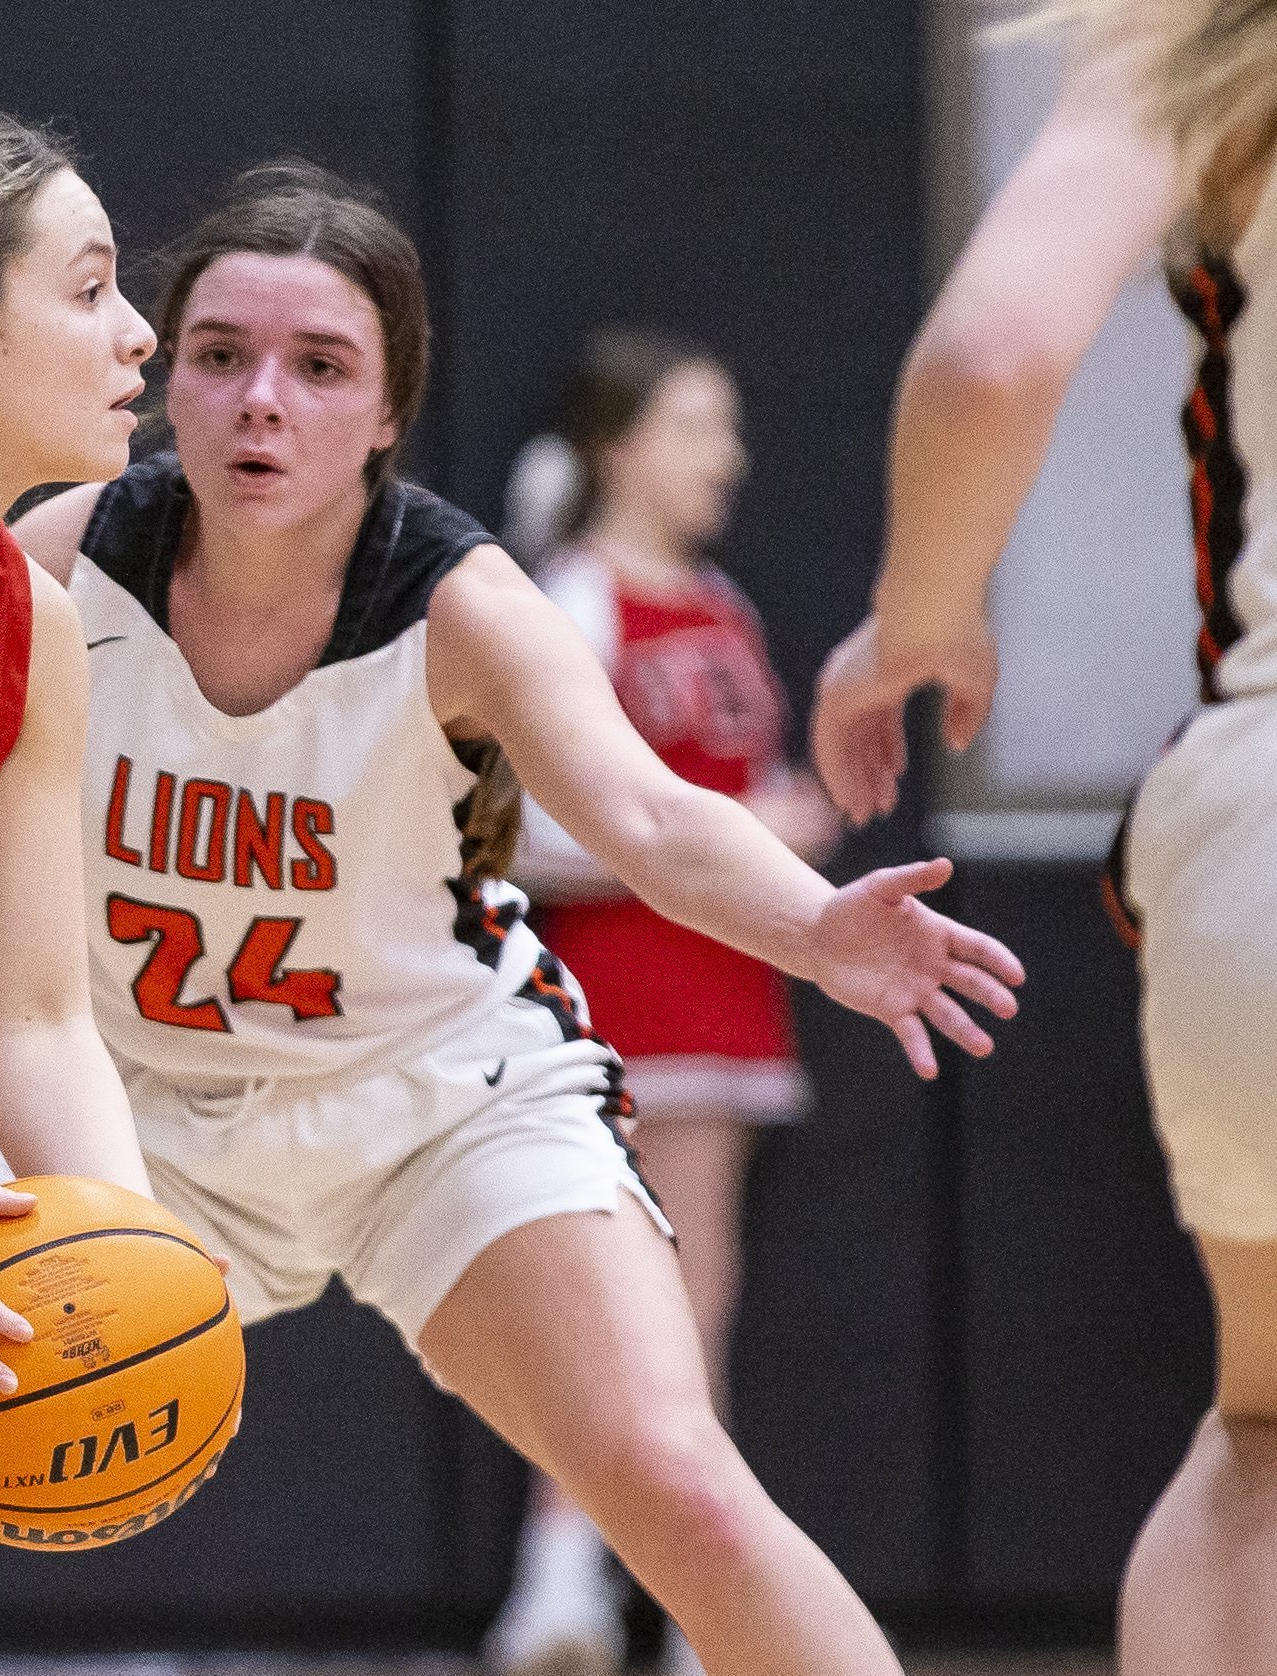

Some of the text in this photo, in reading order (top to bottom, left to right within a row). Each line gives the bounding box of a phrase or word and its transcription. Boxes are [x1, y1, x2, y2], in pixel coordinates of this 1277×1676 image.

[105, 753, 337, 891] LIONS
[105, 891, 345, 1034] 24
[2, 1398, 179, 1489] EVO NXT
